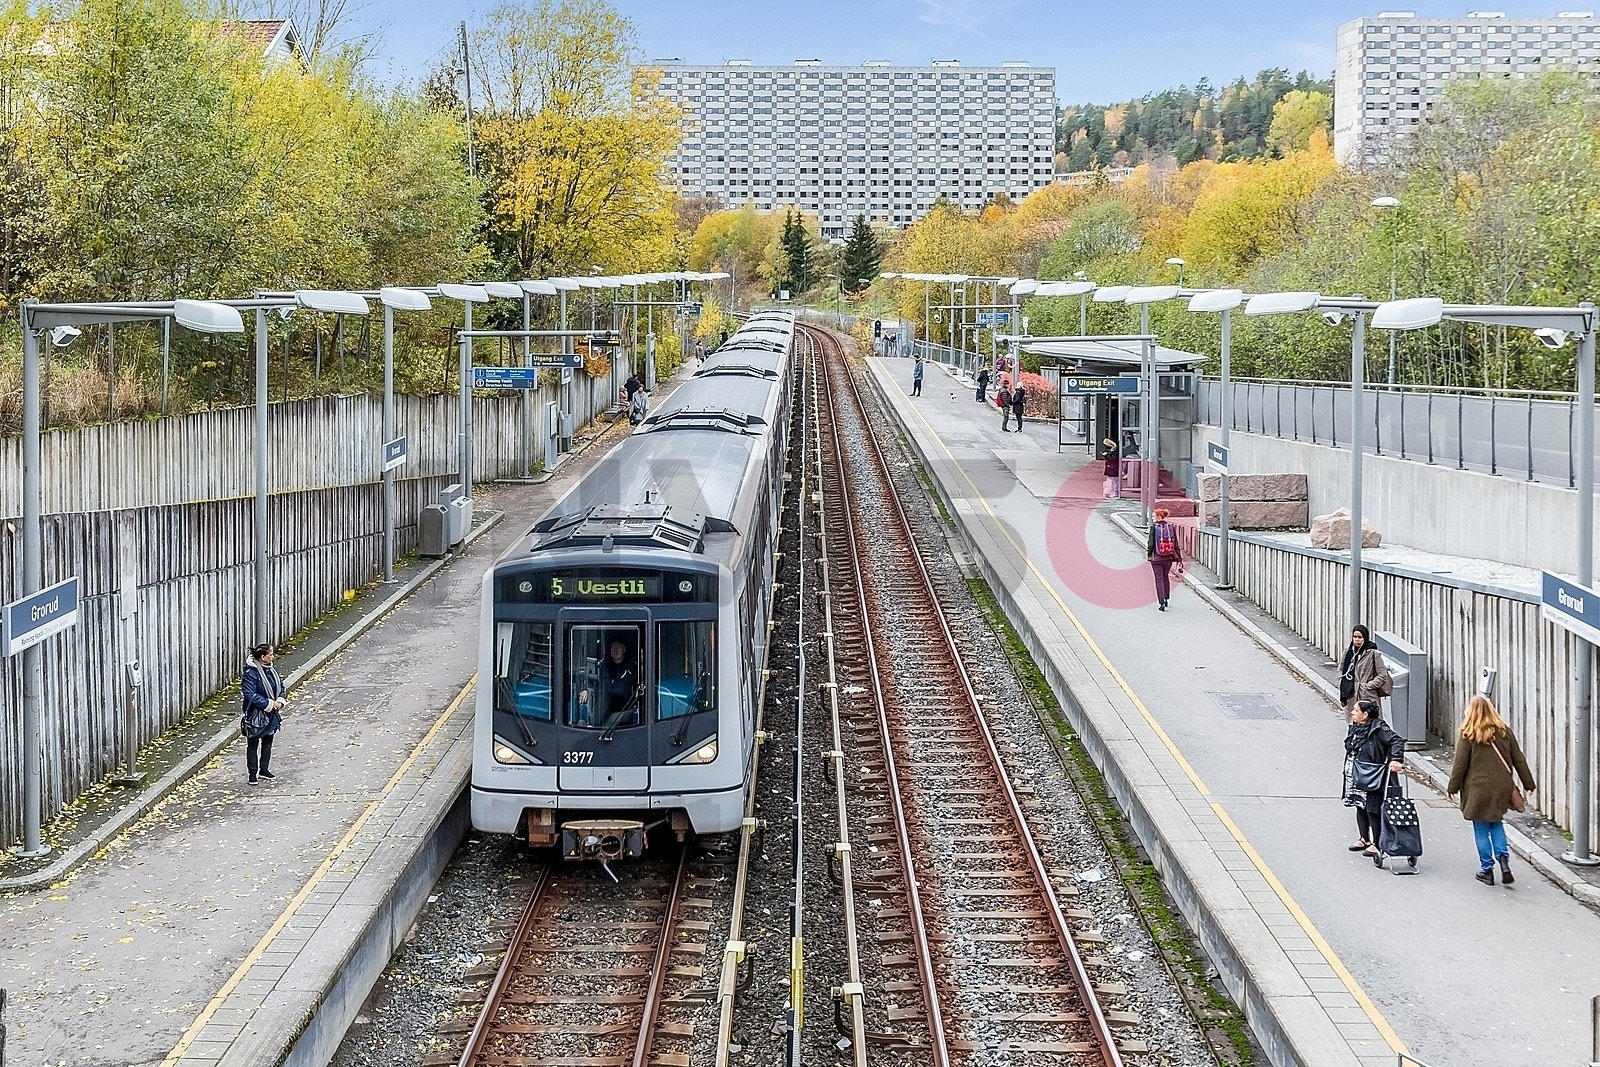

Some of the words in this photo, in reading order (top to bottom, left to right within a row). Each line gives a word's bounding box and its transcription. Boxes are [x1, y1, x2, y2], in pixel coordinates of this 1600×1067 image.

[1079, 379, 1102, 387] Utgang
[552, 578, 563, 596] 5
[578, 580, 646, 595] Vestli
[31, 595, 59, 622] Grorud
[563, 751, 594, 764] 3377
